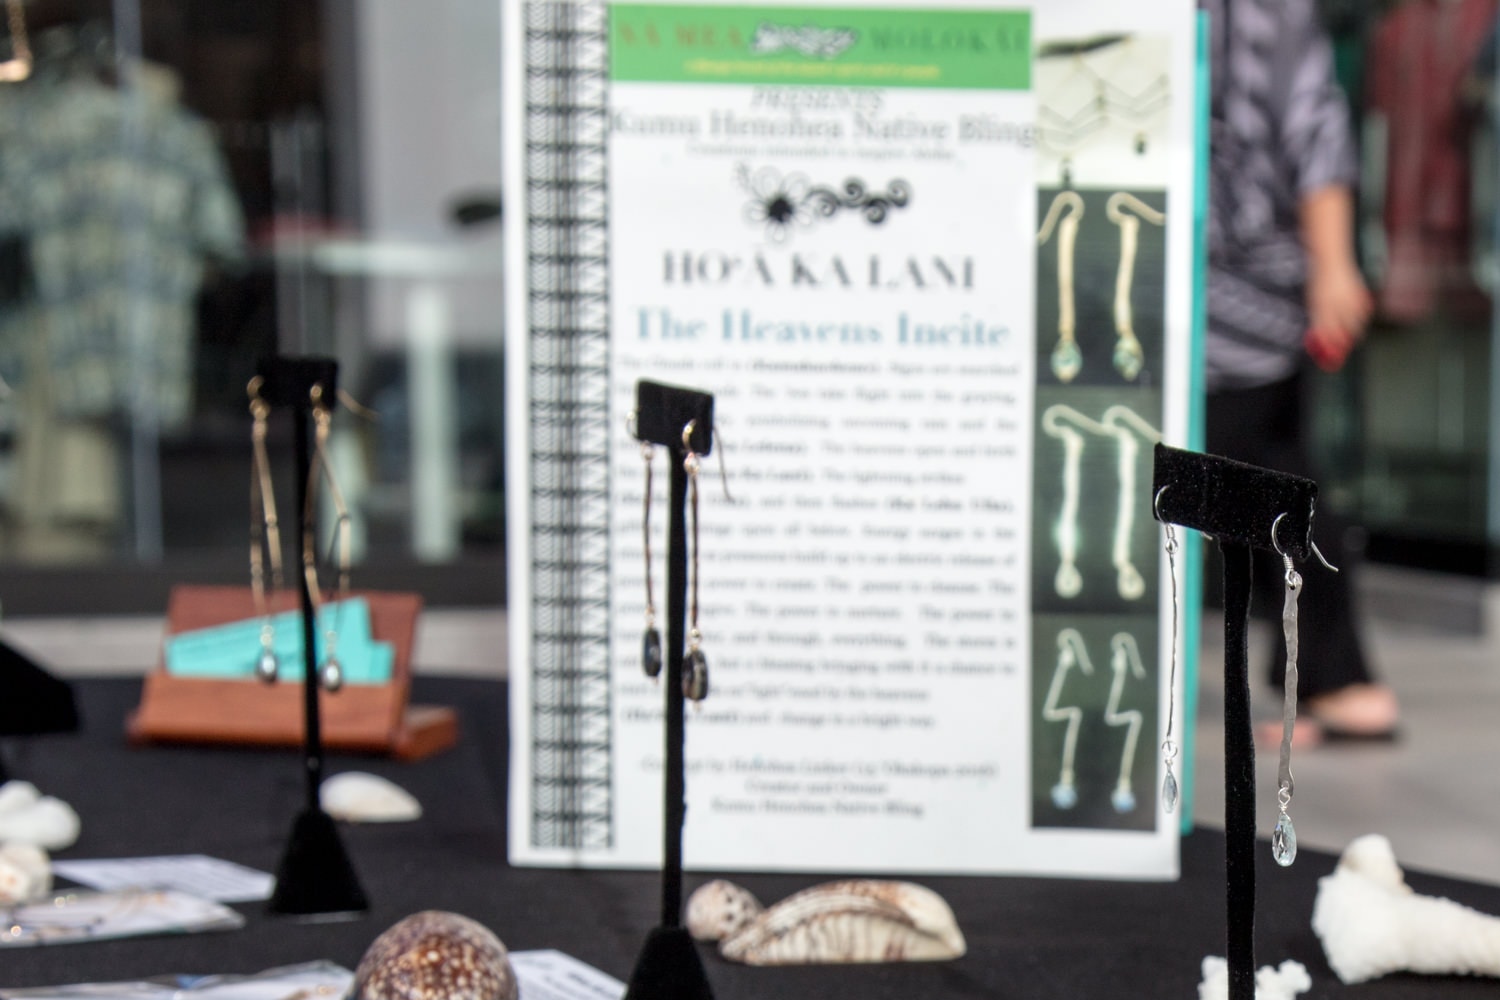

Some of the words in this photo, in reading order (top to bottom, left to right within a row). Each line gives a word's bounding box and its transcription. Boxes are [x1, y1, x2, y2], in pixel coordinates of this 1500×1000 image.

[751, 87, 885, 111] PRESENTS
[853, 114, 950, 140] Native
[790, 251, 853, 287] KA
[868, 253, 975, 290] LANI
[636, 307, 708, 341] The
[721, 308, 883, 345] Heavens
[897, 309, 1010, 348] Incite
